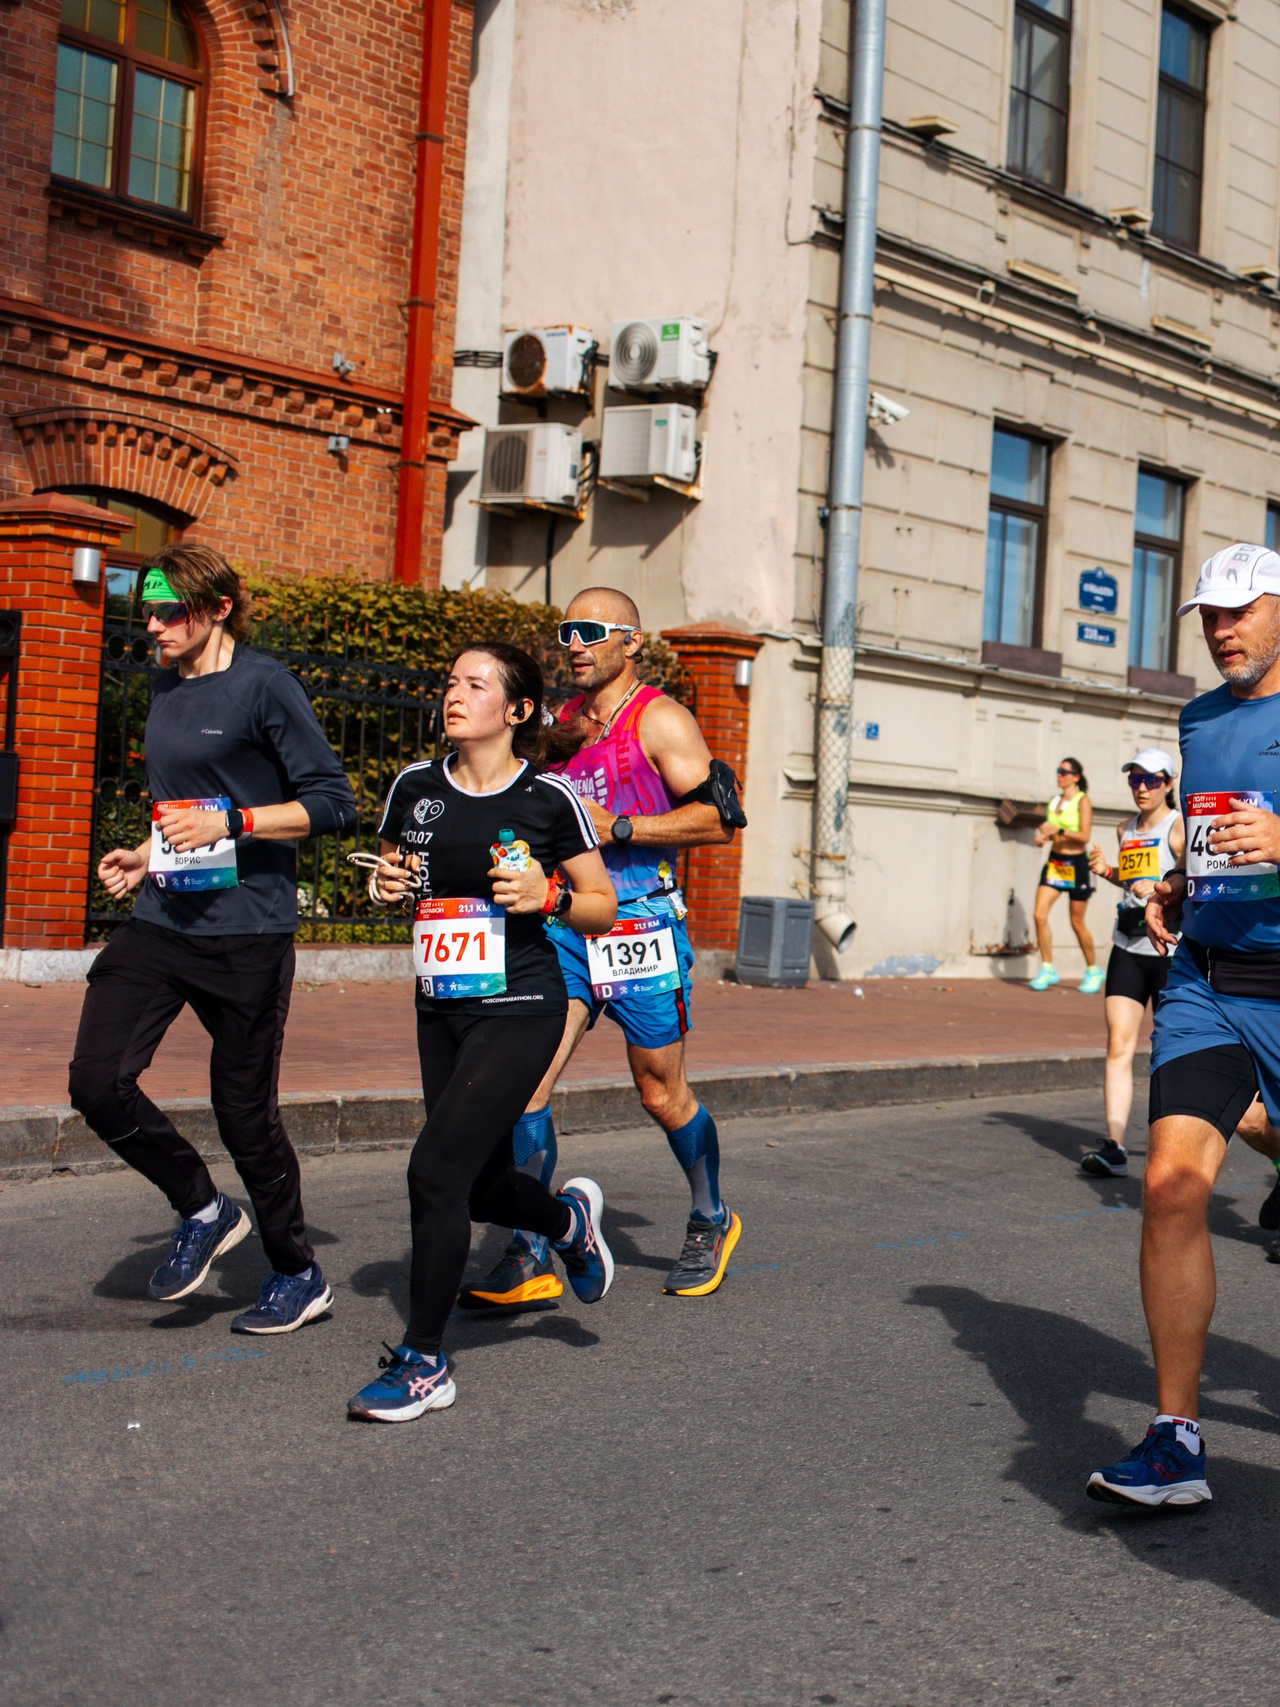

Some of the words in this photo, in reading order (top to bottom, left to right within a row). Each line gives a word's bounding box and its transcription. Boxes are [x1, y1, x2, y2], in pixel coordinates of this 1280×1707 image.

[1192, 801, 1217, 809] МАРАФОН
[175, 856, 201, 865] БОРИС
[1121, 852, 1151, 871] 2571
[156, 873, 166, 888] D
[1187, 879, 1195, 897] D
[458, 904, 474, 914] 21,1
[633, 923, 647, 931] 21,1
[420, 931, 486, 963] 7671
[601, 938, 662, 968] 1391
[612, 964, 659, 977] ВЛАДИМИР
[601, 984, 613, 998] D
